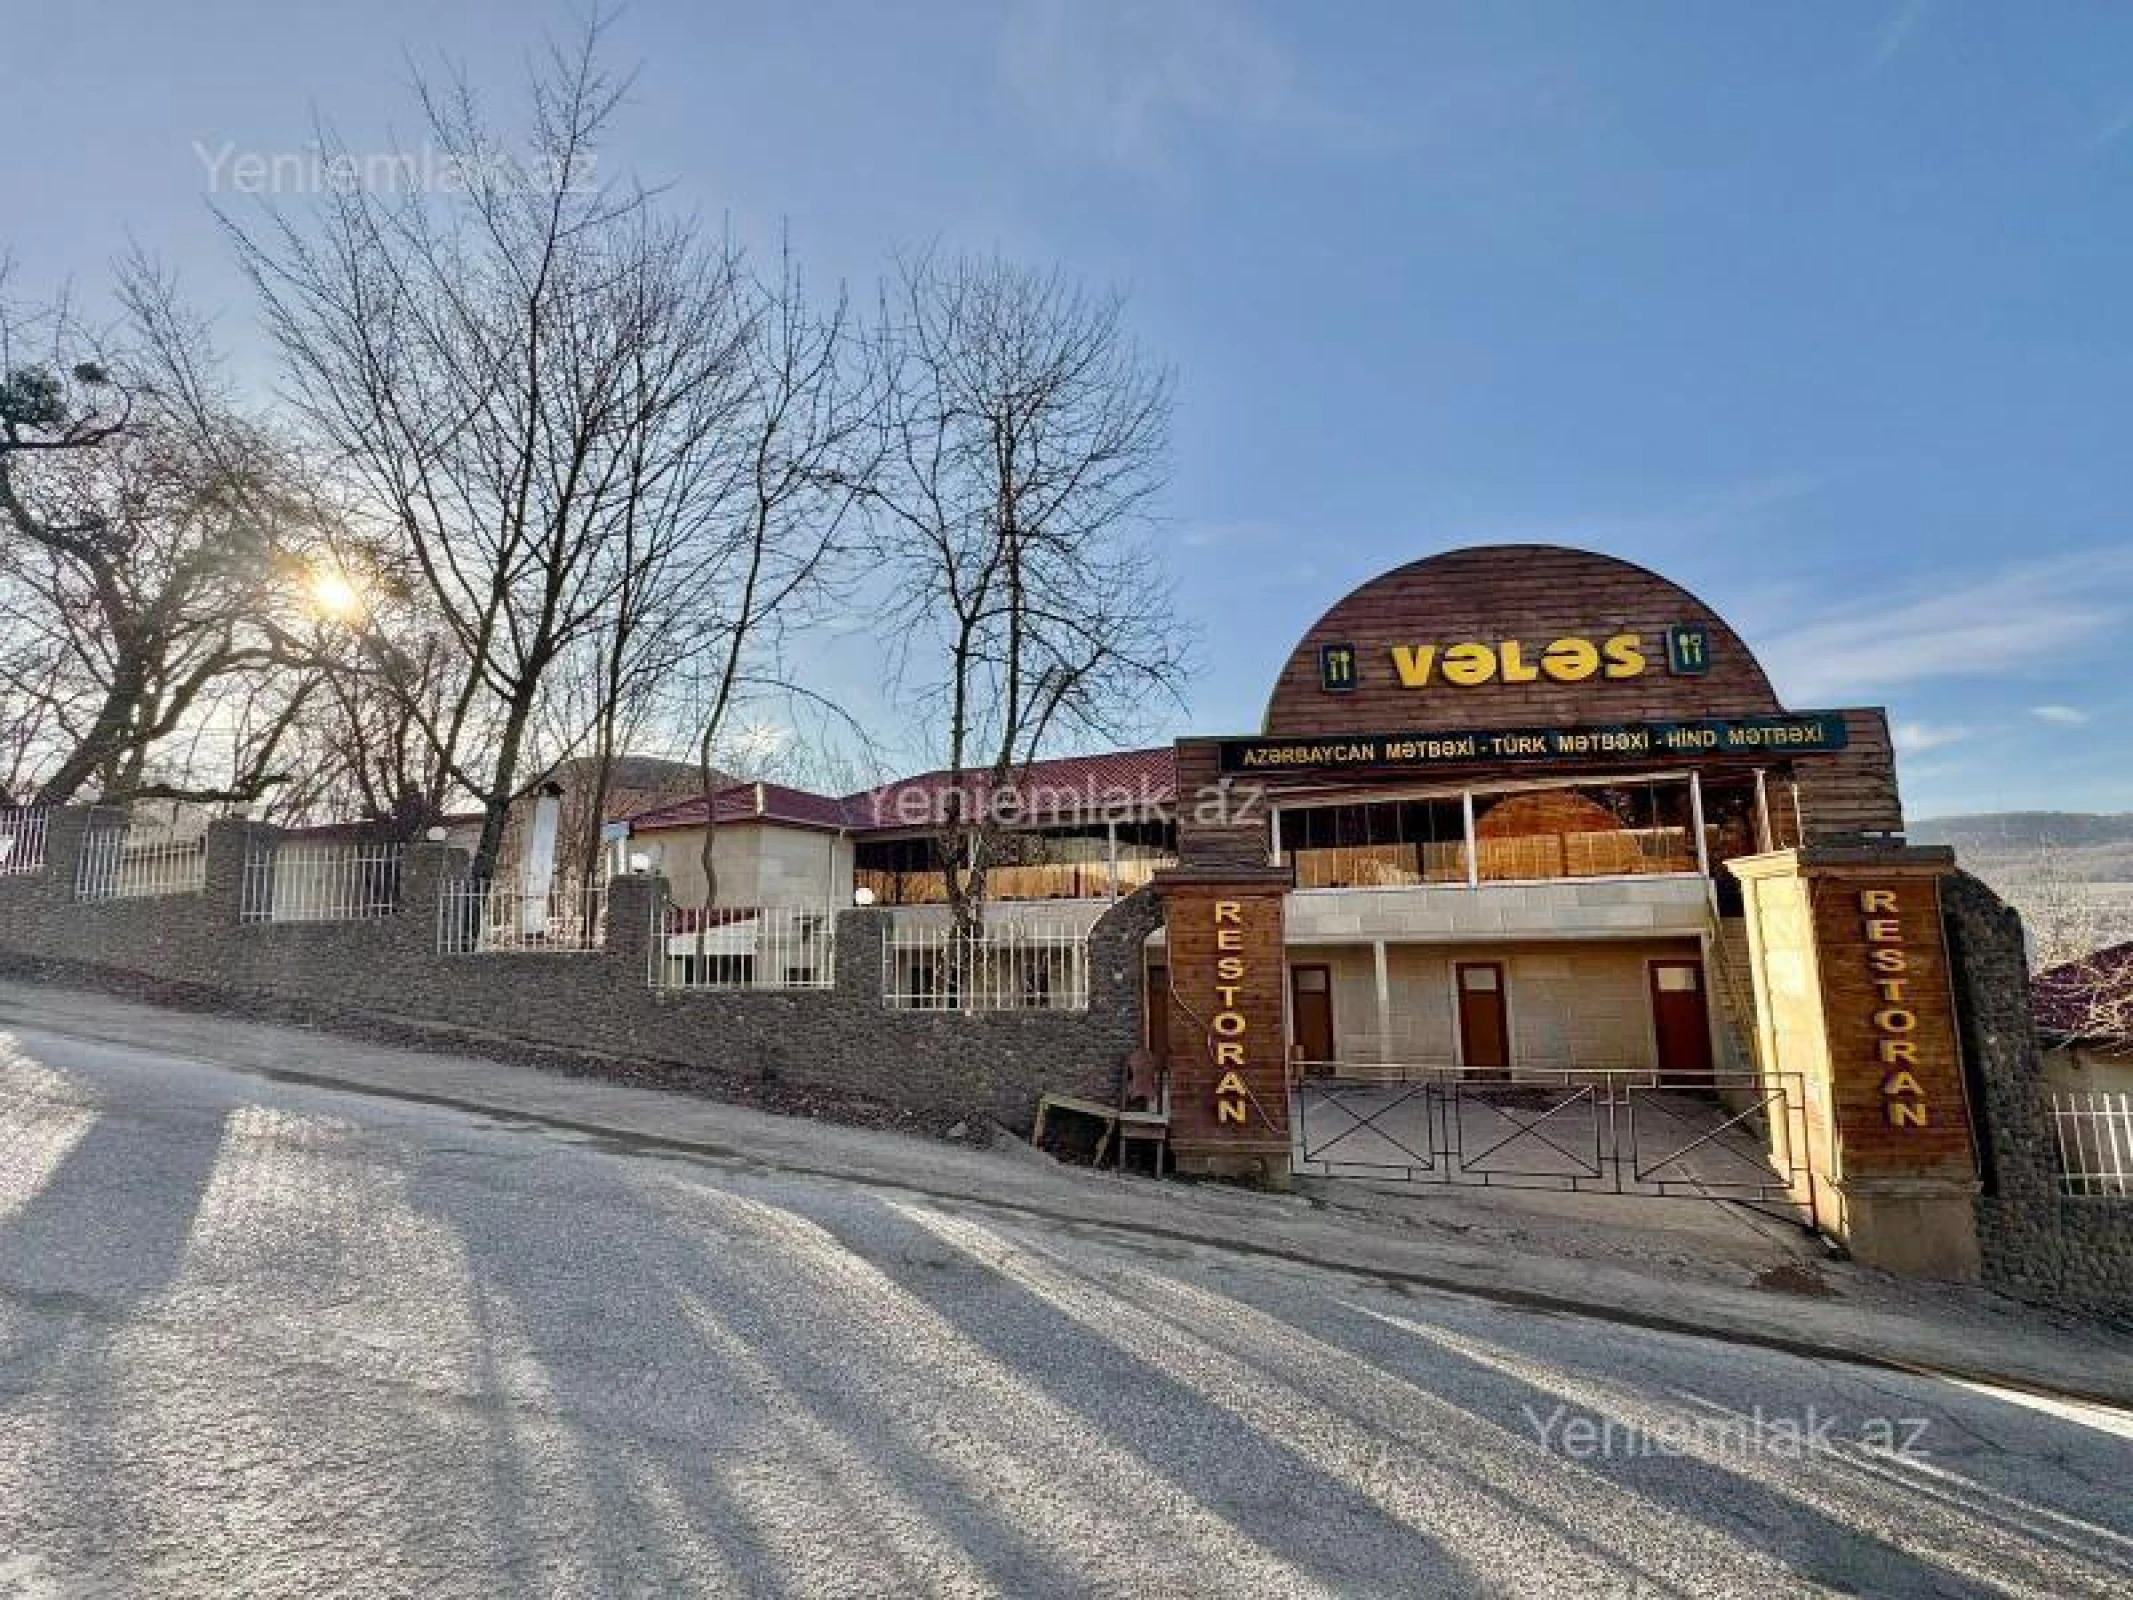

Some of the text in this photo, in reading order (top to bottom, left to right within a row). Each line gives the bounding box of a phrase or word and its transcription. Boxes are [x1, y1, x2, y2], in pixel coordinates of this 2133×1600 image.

[1391, 633, 1647, 688] VƏLƏS
[1244, 743, 1375, 766] AZƏRBAYCAN
[1385, 736, 1475, 760] MƏTBƏXİ
[1493, 736, 1547, 757] TÜRK
[1558, 732, 1649, 753] MƏTBƏXİ
[1667, 727, 1718, 748] HİND
[1728, 723, 1824, 746] MƏTBƏXİ
[1213, 900, 1246, 1124] RESTORAN
[1860, 889, 1927, 1126] RESTORAN
